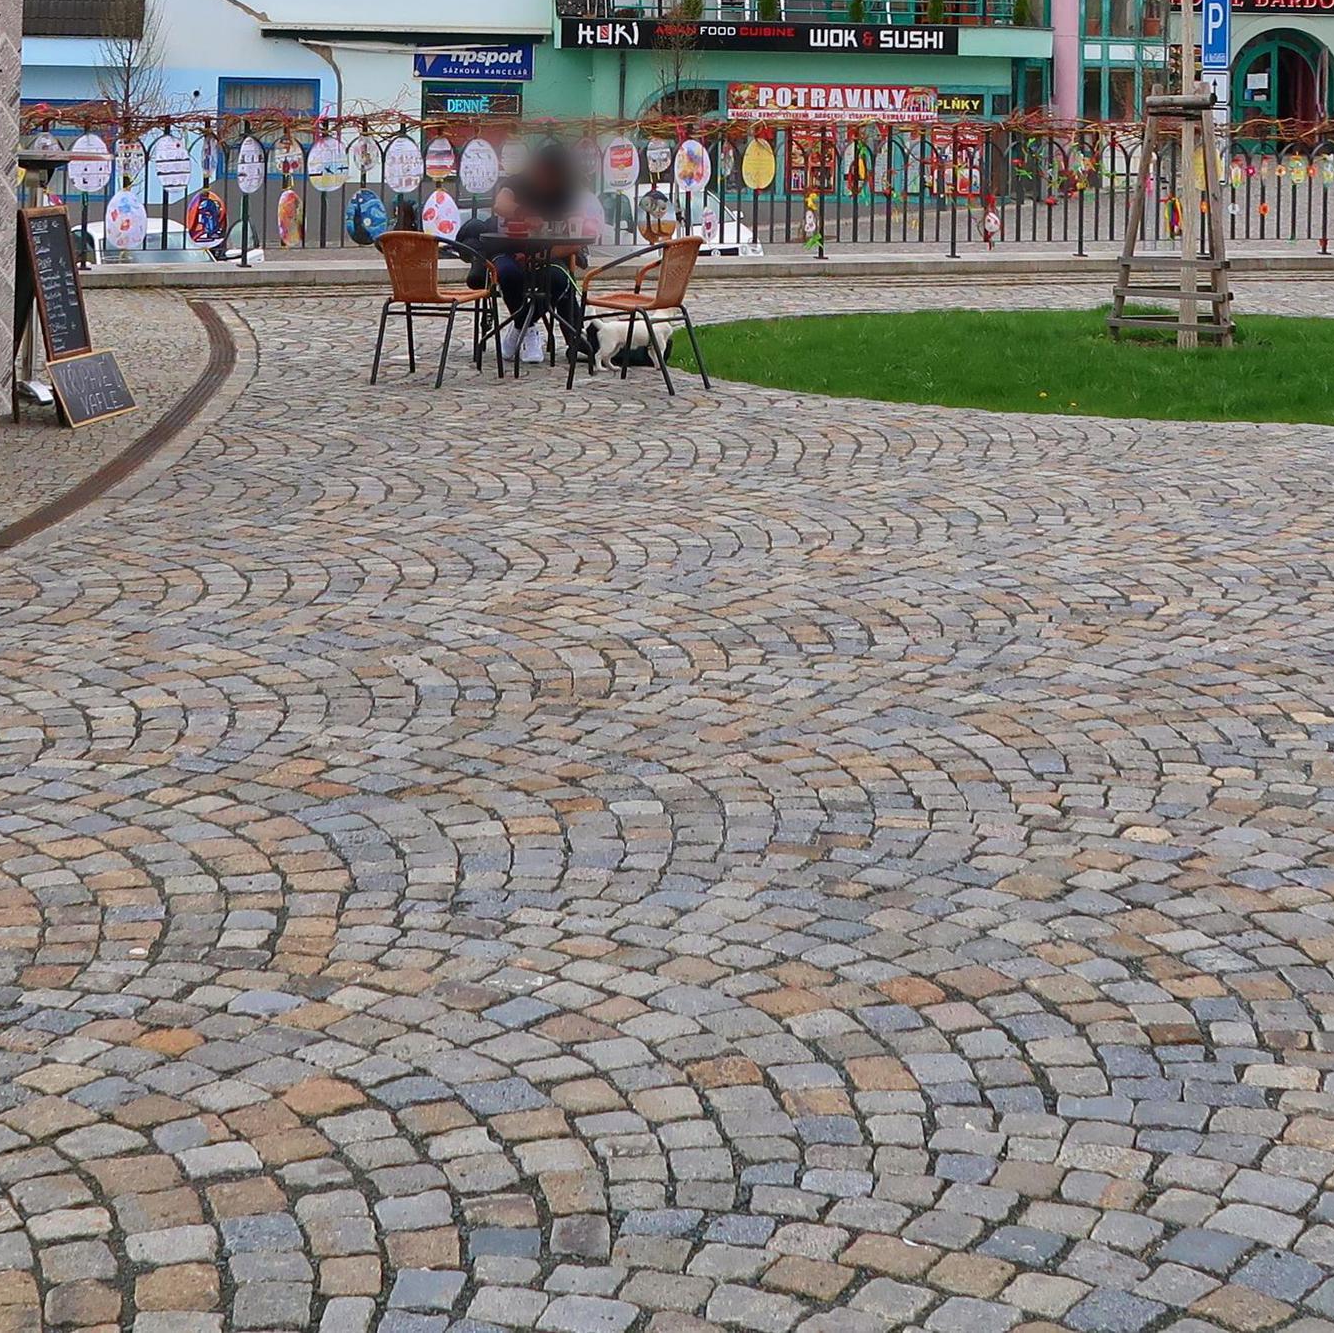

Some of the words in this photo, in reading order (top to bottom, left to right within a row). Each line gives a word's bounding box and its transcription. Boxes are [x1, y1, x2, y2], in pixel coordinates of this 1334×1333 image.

[1208, 2, 1223, 46] P
[699, 26, 737, 37] FOOD
[739, 27, 796, 38] CUISINE
[809, 28, 858, 48] WOK
[862, 31, 874, 47] &
[879, 30, 943, 49] SUSHI
[447, 95, 490, 113] DENNĚ
[758, 86, 907, 109] POTRAVINY
